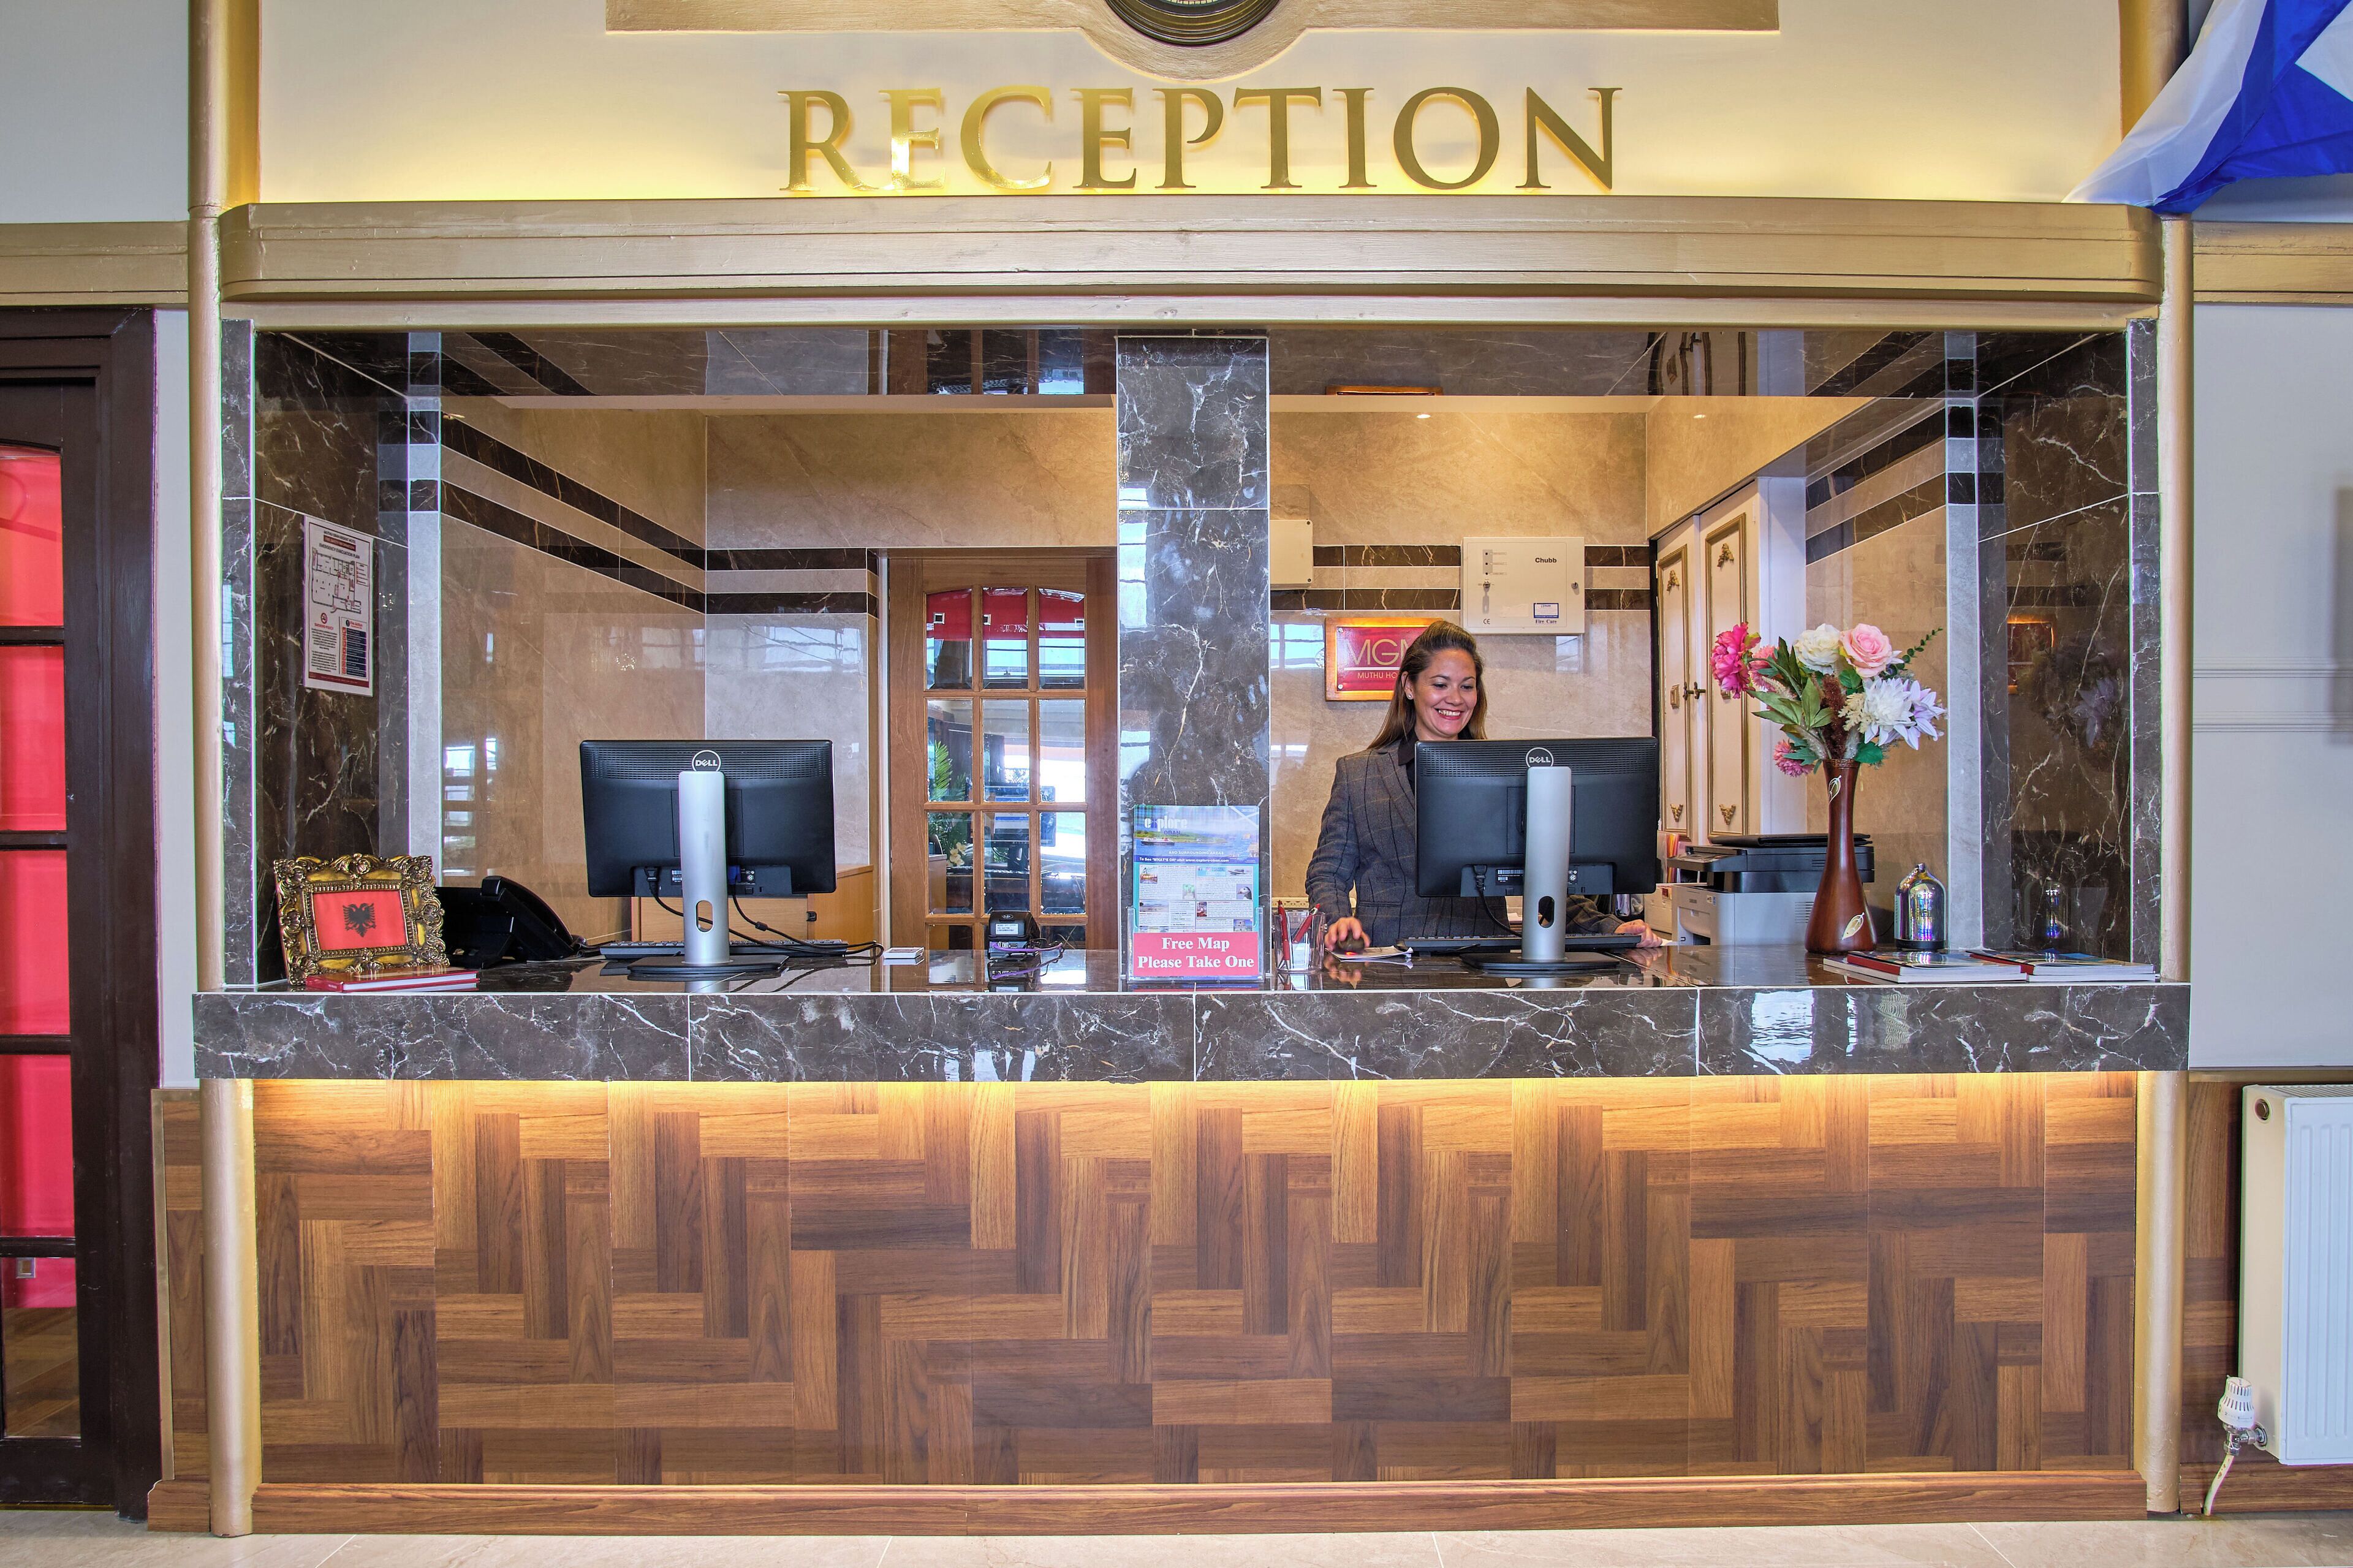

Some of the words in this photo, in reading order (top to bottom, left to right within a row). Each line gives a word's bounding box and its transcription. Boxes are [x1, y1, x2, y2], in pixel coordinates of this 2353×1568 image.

[777, 85, 1623, 191] RECEPTION
[1161, 937, 1194, 950] Free
[1197, 937, 1230, 952] Map
[1137, 956, 1182, 968] Please
[1186, 956, 1221, 968] Take
[1224, 956, 1254, 968] One
